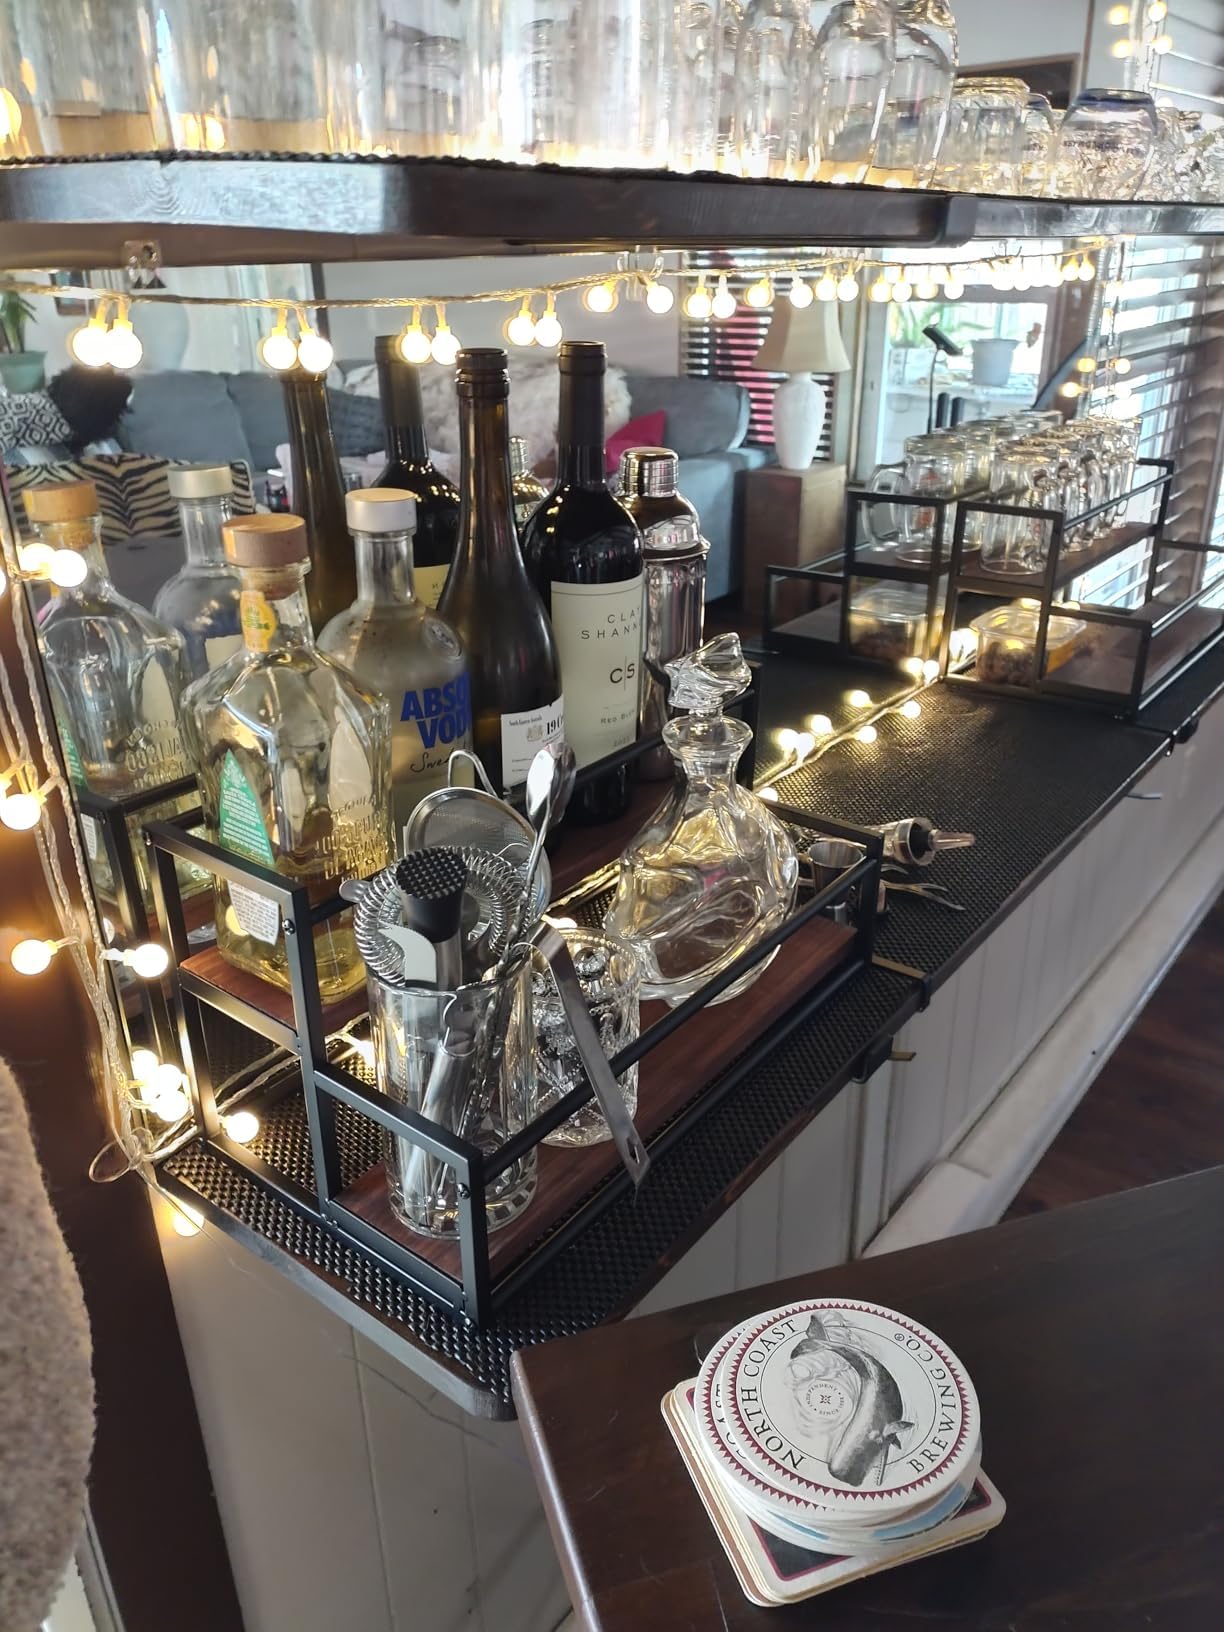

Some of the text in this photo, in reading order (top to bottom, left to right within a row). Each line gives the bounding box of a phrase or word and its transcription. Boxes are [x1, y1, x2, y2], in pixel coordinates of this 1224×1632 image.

[743, 1319, 800, 1377] COAST
[741, 1386, 807, 1471] NORTH
[907, 1368, 957, 1473] BREWING
